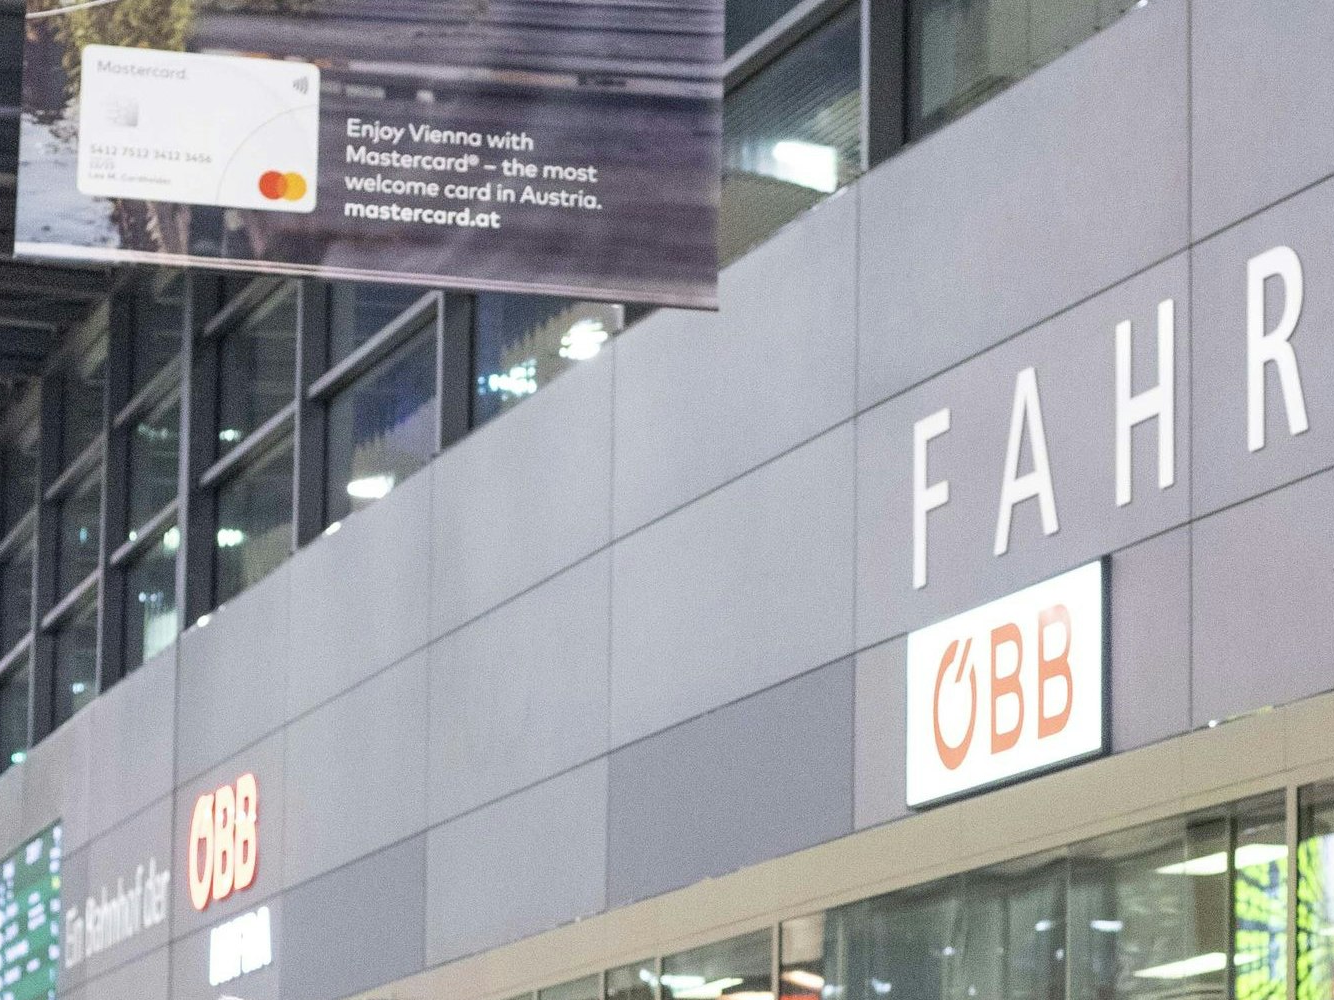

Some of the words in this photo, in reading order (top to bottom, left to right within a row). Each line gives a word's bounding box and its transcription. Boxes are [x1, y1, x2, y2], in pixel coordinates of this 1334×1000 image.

[346, 117, 405, 145] Enjoy
[408, 122, 482, 148] Vienna
[486, 131, 535, 151] with
[502, 158, 538, 178] the
[542, 164, 598, 183] most
[344, 174, 440, 197] welcome
[443, 183, 491, 201] card
[496, 184, 516, 202] in
[519, 185, 602, 210] Austria.
[344, 202, 501, 229] mastercard.at
[932, 602, 1073, 771] ÖBB
[188, 772, 258, 912] ÖBB
